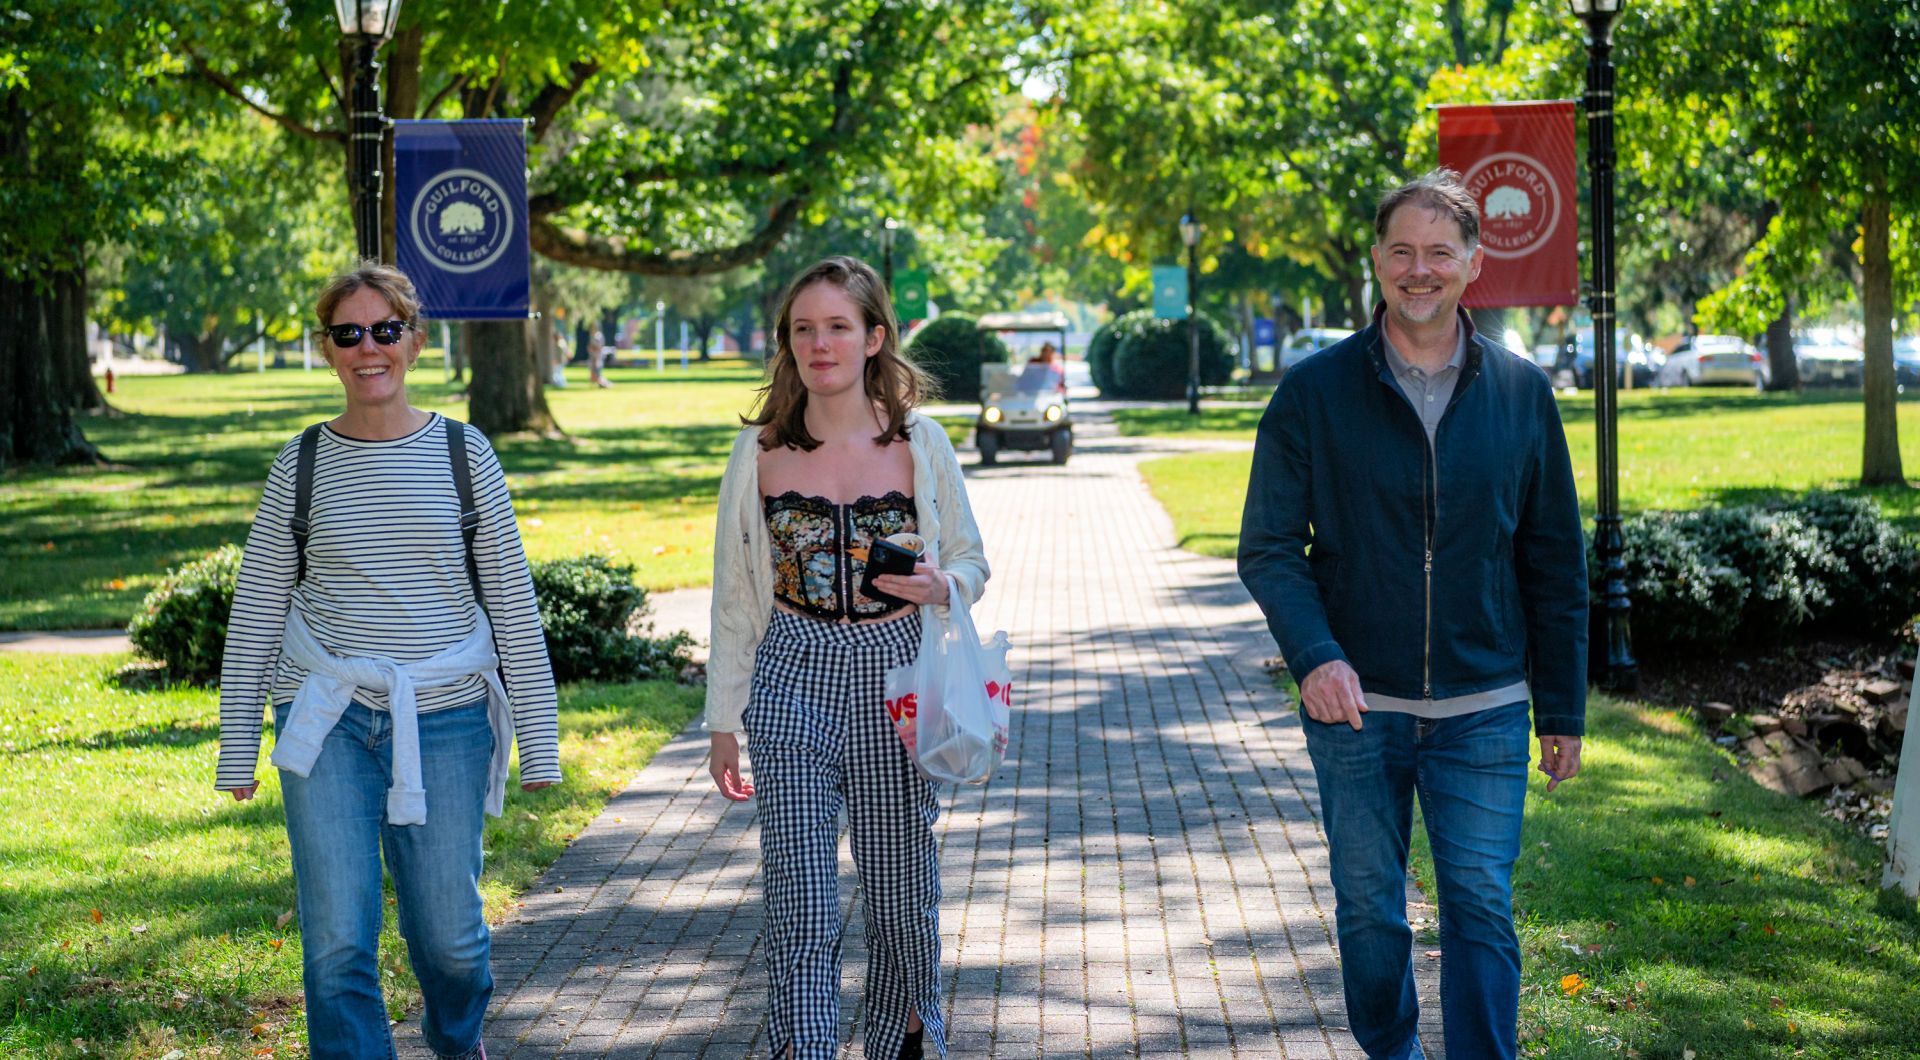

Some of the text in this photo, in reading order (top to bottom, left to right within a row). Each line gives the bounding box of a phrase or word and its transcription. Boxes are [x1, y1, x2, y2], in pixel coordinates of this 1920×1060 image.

[1471, 163, 1545, 198] GUILFORD
[425, 180, 499, 214] GUILFORD
[1482, 230, 1535, 247] COLLEGE
[437, 245, 489, 261] COLLEGE
